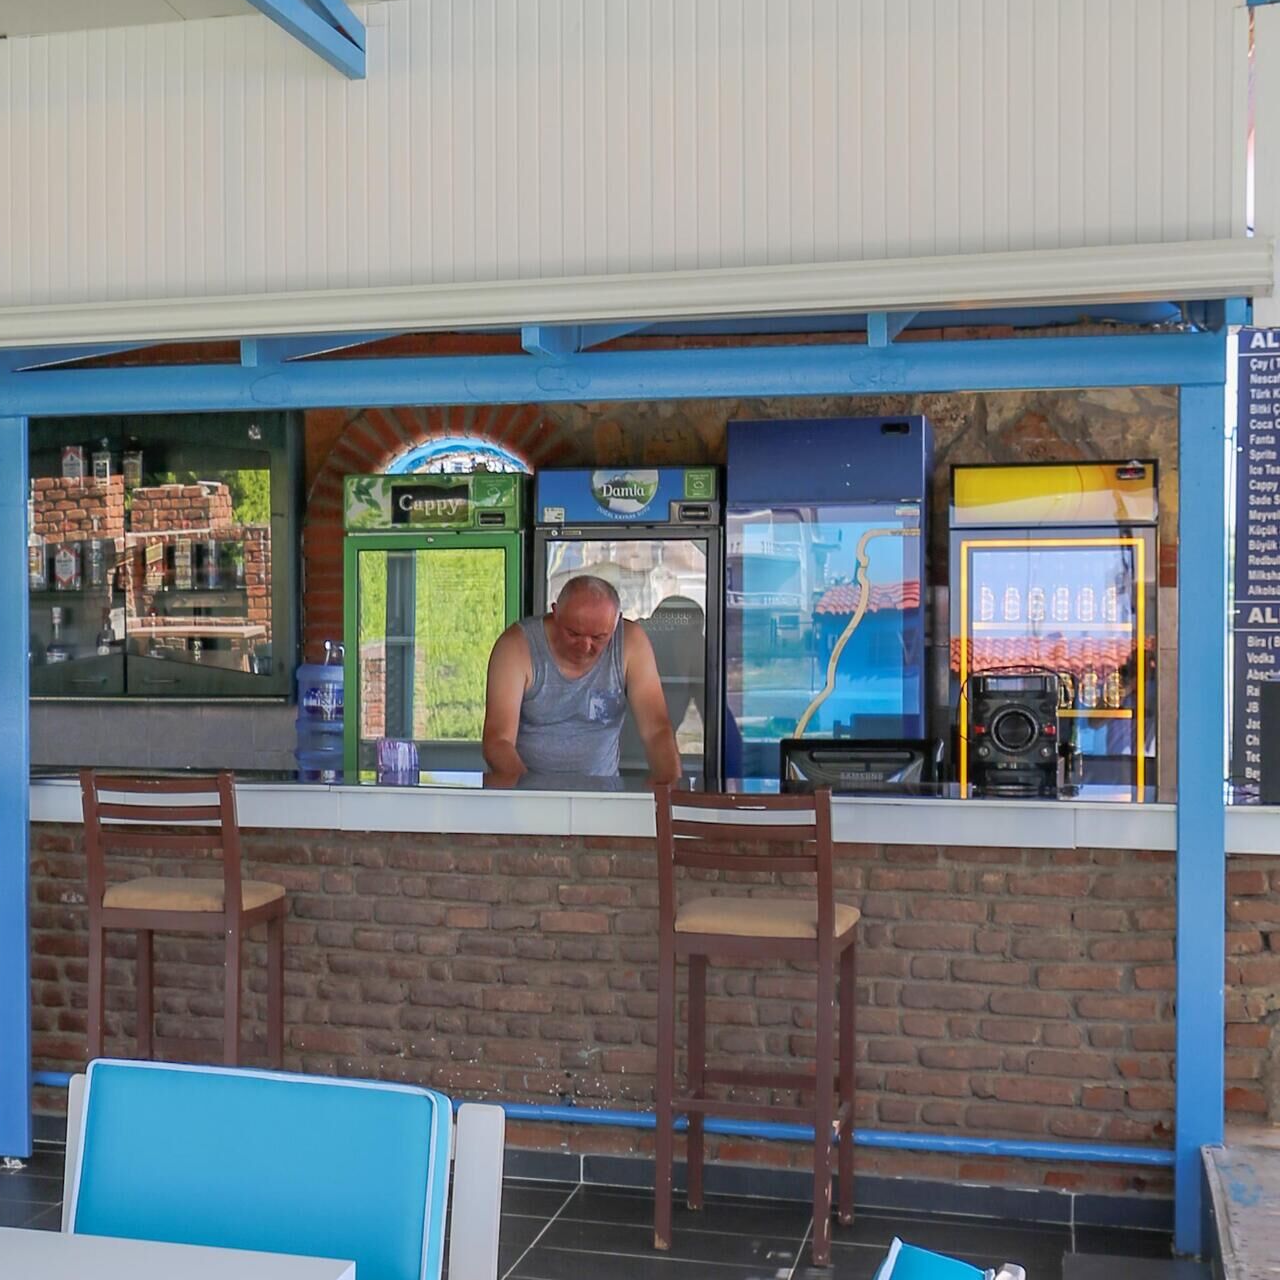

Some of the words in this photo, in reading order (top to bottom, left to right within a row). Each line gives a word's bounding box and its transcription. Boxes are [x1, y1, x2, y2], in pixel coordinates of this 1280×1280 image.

[1249, 388, 1271, 399] Türk
[1249, 419, 1273, 430] Coca
[1249, 434, 1276, 445] Fanta
[1249, 449, 1277, 462] Sprite
[1249, 465, 1263, 475] Ice
[603, 484, 645, 497] Damla
[1248, 480, 1279, 492] Cappy
[399, 494, 461, 516] Cappy
[1248, 495, 1272, 505] Sade
[1248, 525, 1278, 537] Küçük
[1247, 540, 1278, 552] Büyük
[1247, 636, 1267, 647] Bira
[1246, 652, 1276, 664] Vodka
